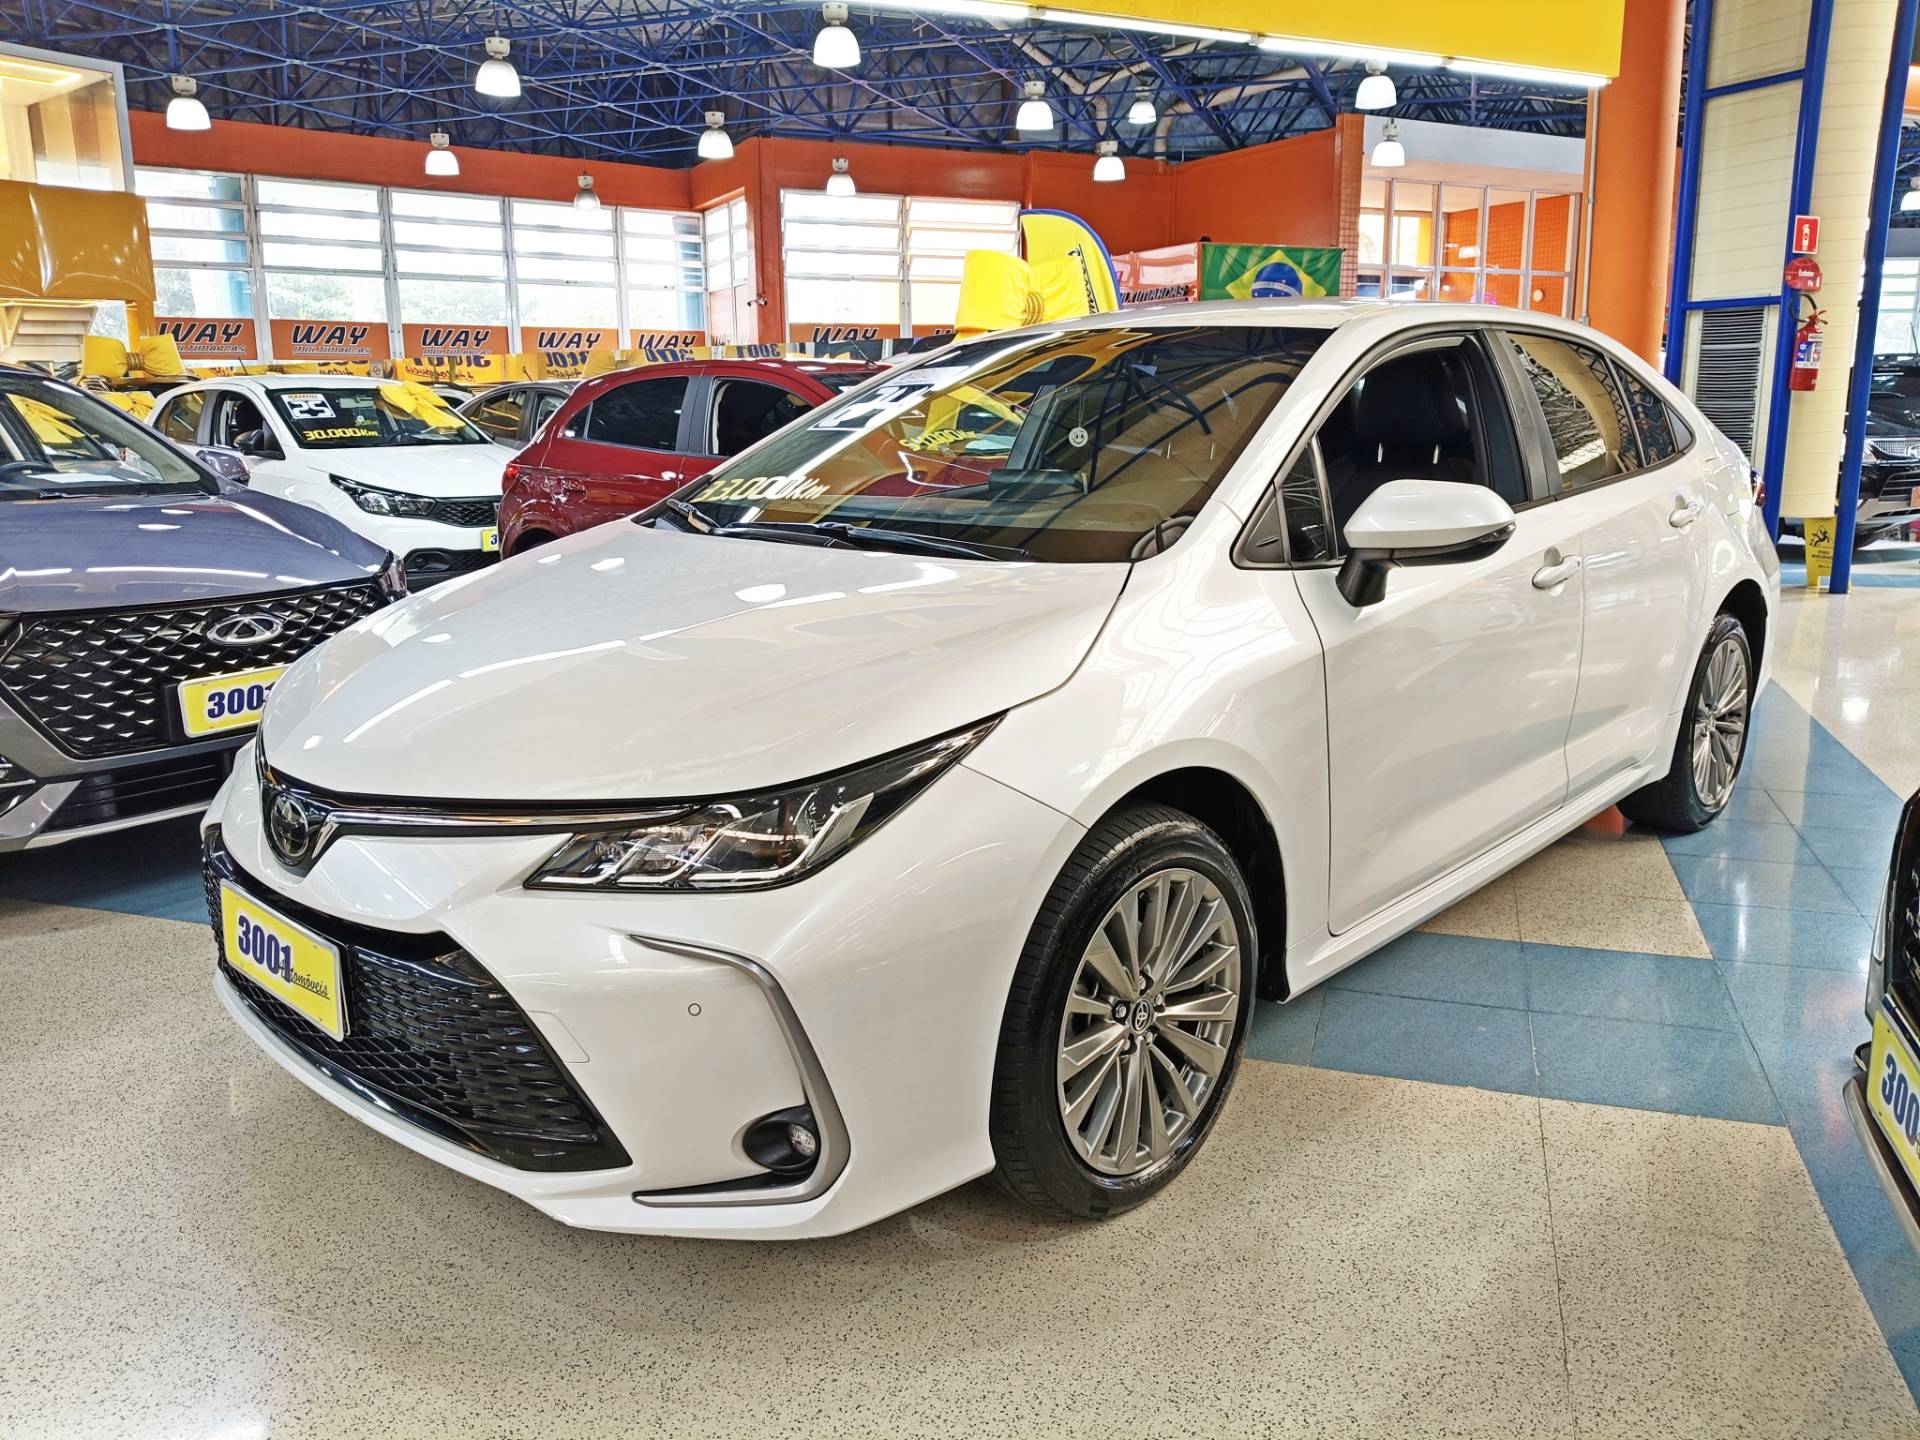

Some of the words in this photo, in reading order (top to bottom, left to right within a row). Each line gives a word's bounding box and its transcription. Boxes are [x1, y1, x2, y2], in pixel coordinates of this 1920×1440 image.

[158, 322, 243, 343] WAY
[292, 324, 369, 345] WAY
[422, 328, 491, 348] WAY
[537, 331, 601, 349] WAY
[638, 333, 696, 349] WAY
[290, 400, 333, 417] 25
[208, 682, 275, 718] 300
[238, 915, 291, 983] 3001
